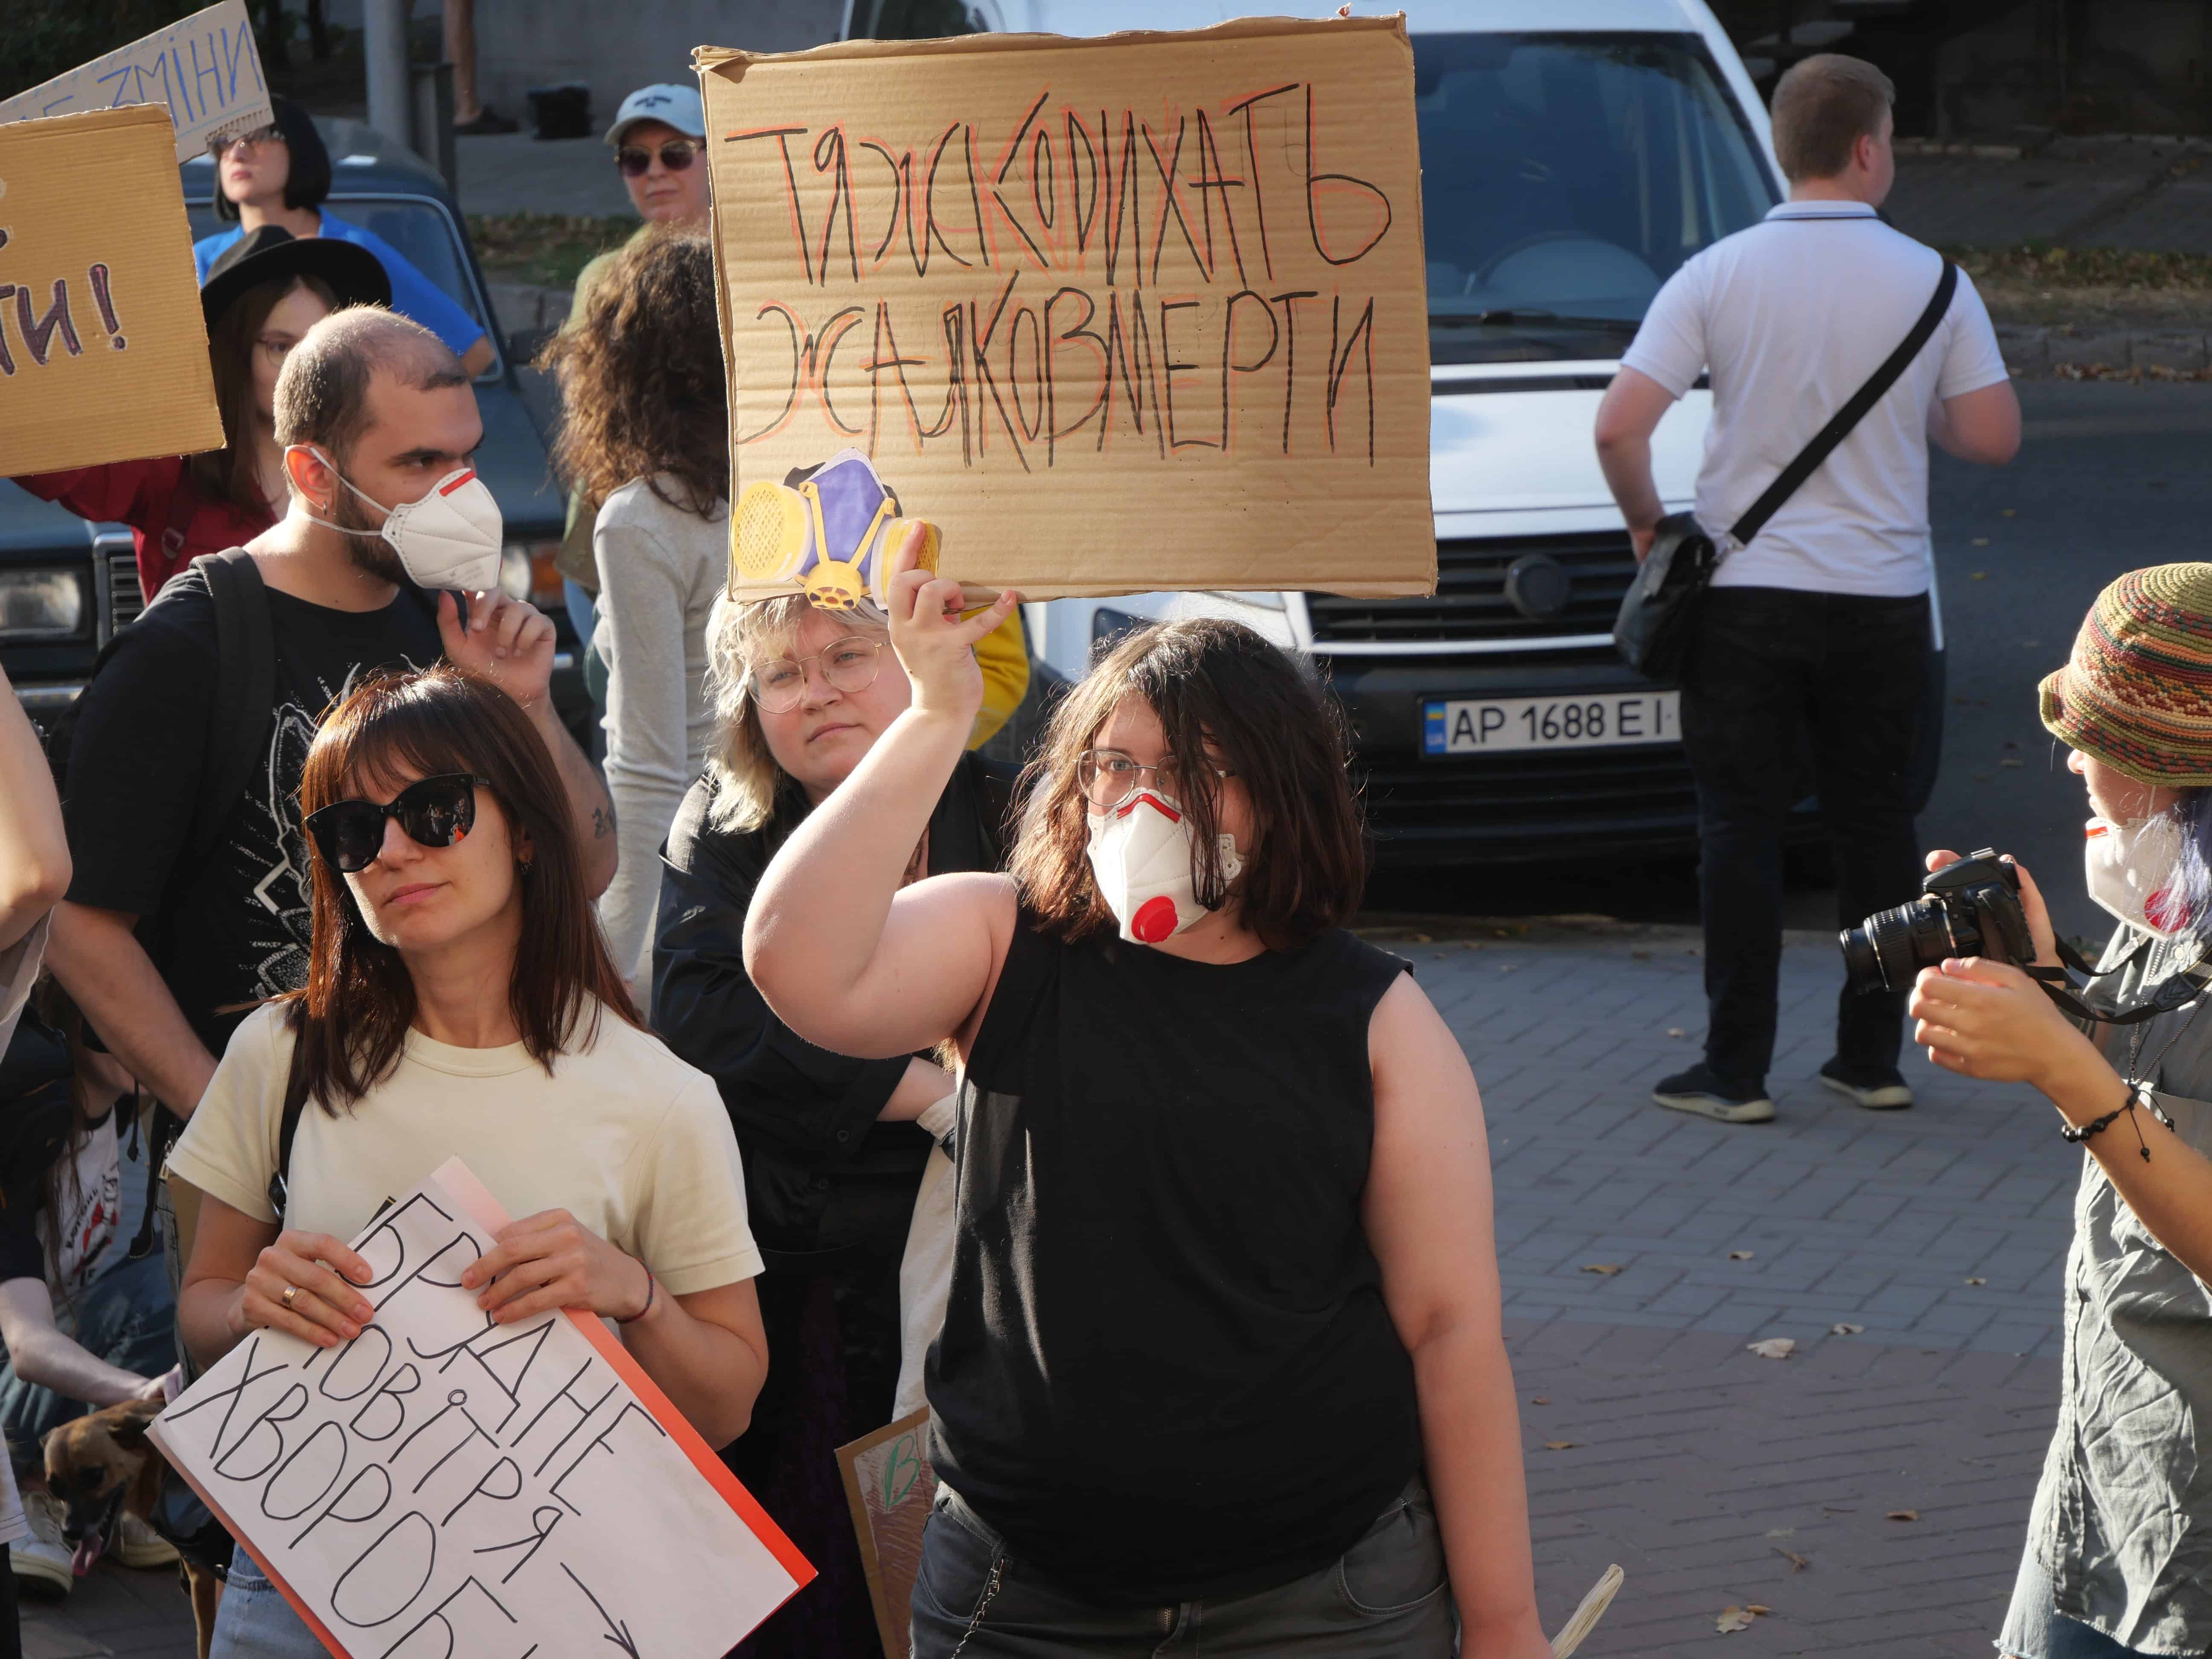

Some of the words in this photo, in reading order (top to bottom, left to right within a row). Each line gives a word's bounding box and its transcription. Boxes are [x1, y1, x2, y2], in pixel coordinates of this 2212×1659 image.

[1452, 707, 1505, 745] AP
[1520, 702, 1605, 742] 1688
[164, 1336, 539, 1659] ХВОРОБ
[264, 1324, 564, 1584] ОВІТРЯ
